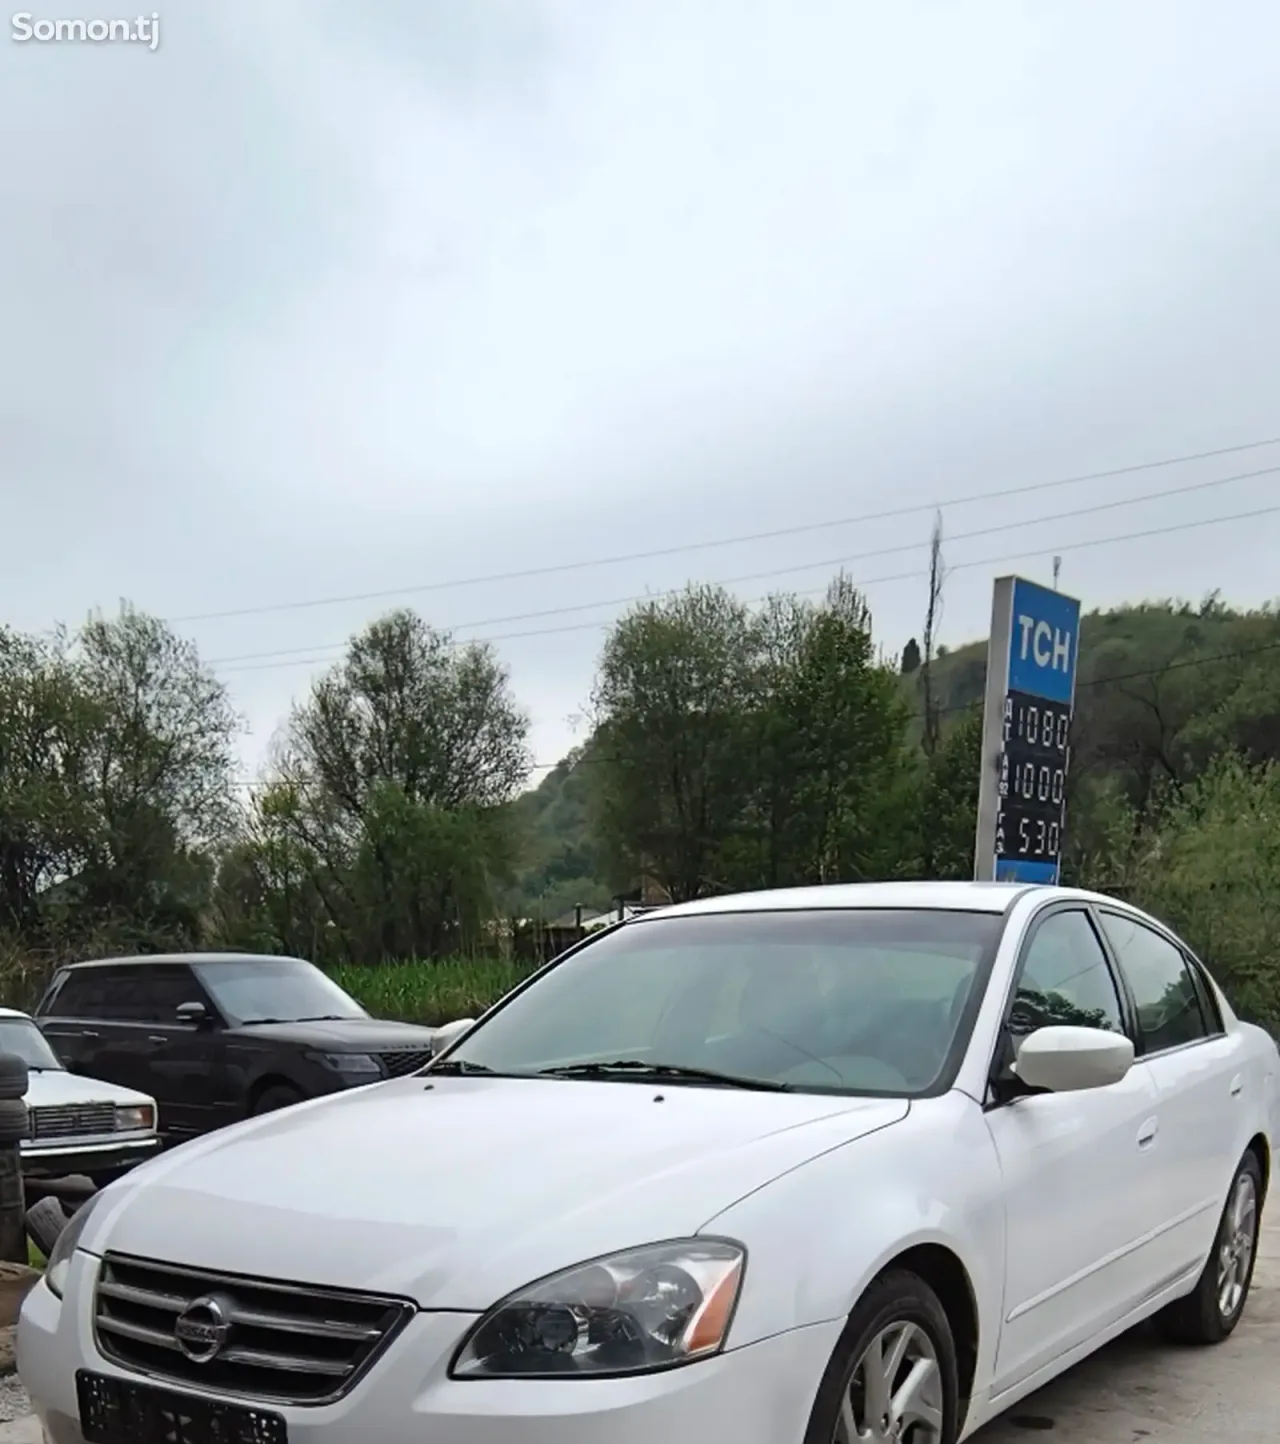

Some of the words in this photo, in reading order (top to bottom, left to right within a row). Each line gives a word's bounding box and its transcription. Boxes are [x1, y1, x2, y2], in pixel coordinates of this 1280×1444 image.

[1018, 706, 1069, 750] 1080
[1014, 763, 1065, 804] 1000
[1019, 817, 1059, 855] 530
